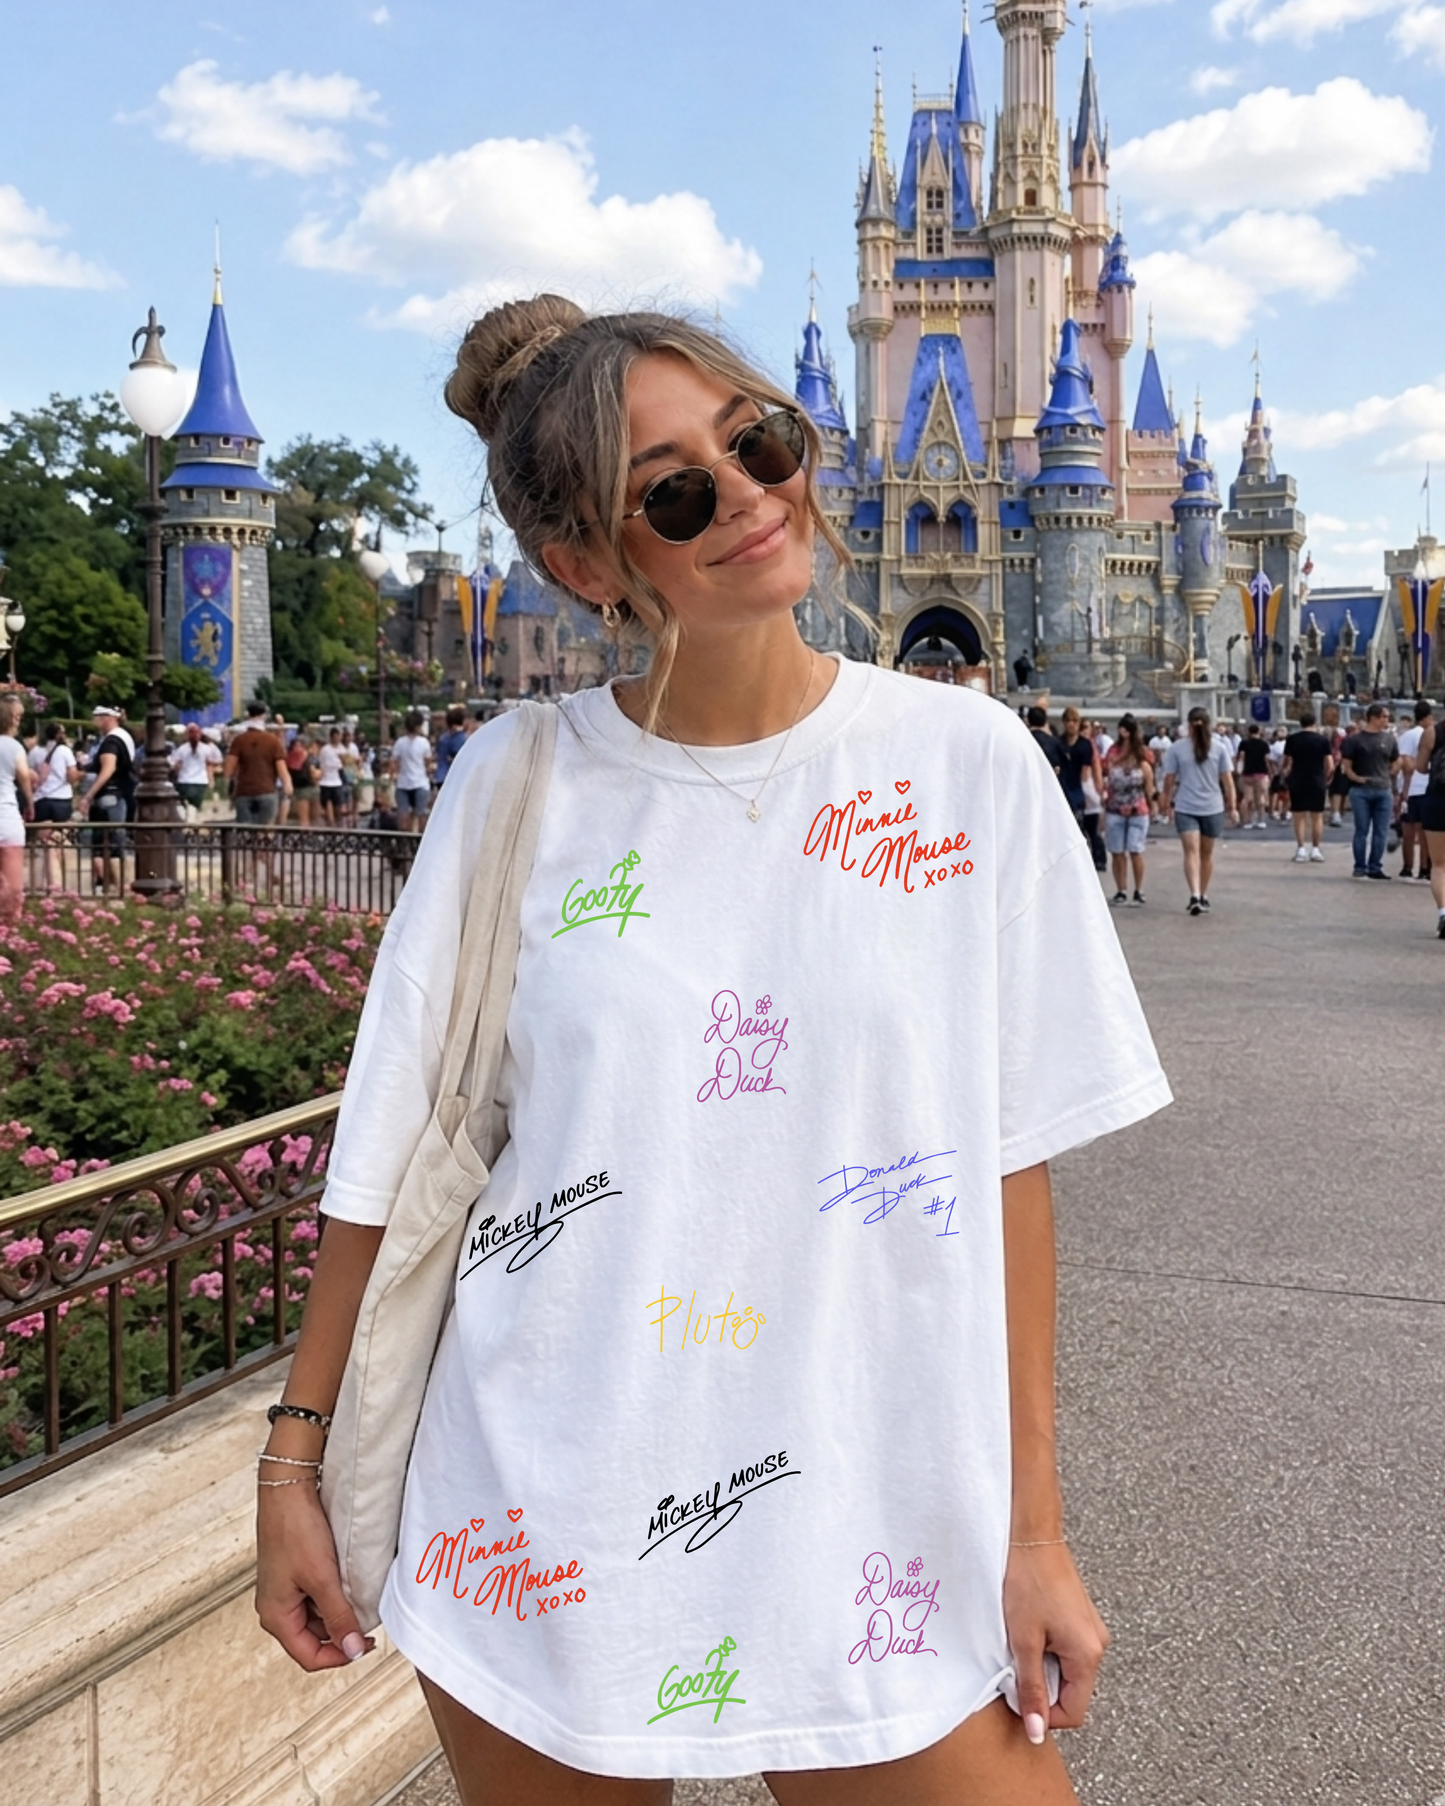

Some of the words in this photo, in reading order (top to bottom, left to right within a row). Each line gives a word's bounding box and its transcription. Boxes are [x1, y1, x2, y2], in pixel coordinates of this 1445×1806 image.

[803, 780, 918, 871] Minnie
[861, 830, 972, 893] Mouse
[704, 989, 789, 1070] Daisy
[697, 1046, 787, 1103] Duck
[549, 1170, 611, 1214] MOUSE
[818, 1150, 957, 1212] Donald
[851, 1172, 953, 1225] Duck
[923, 1195, 960, 1237] #1
[645, 1284, 764, 1353] Pluto
[728, 1450, 789, 1494] MOUSE
[416, 1507, 530, 1600] Minnie
[473, 1557, 584, 1622] Mouse
[855, 1551, 940, 1632] Daisy
[848, 1608, 938, 1665] Duck
